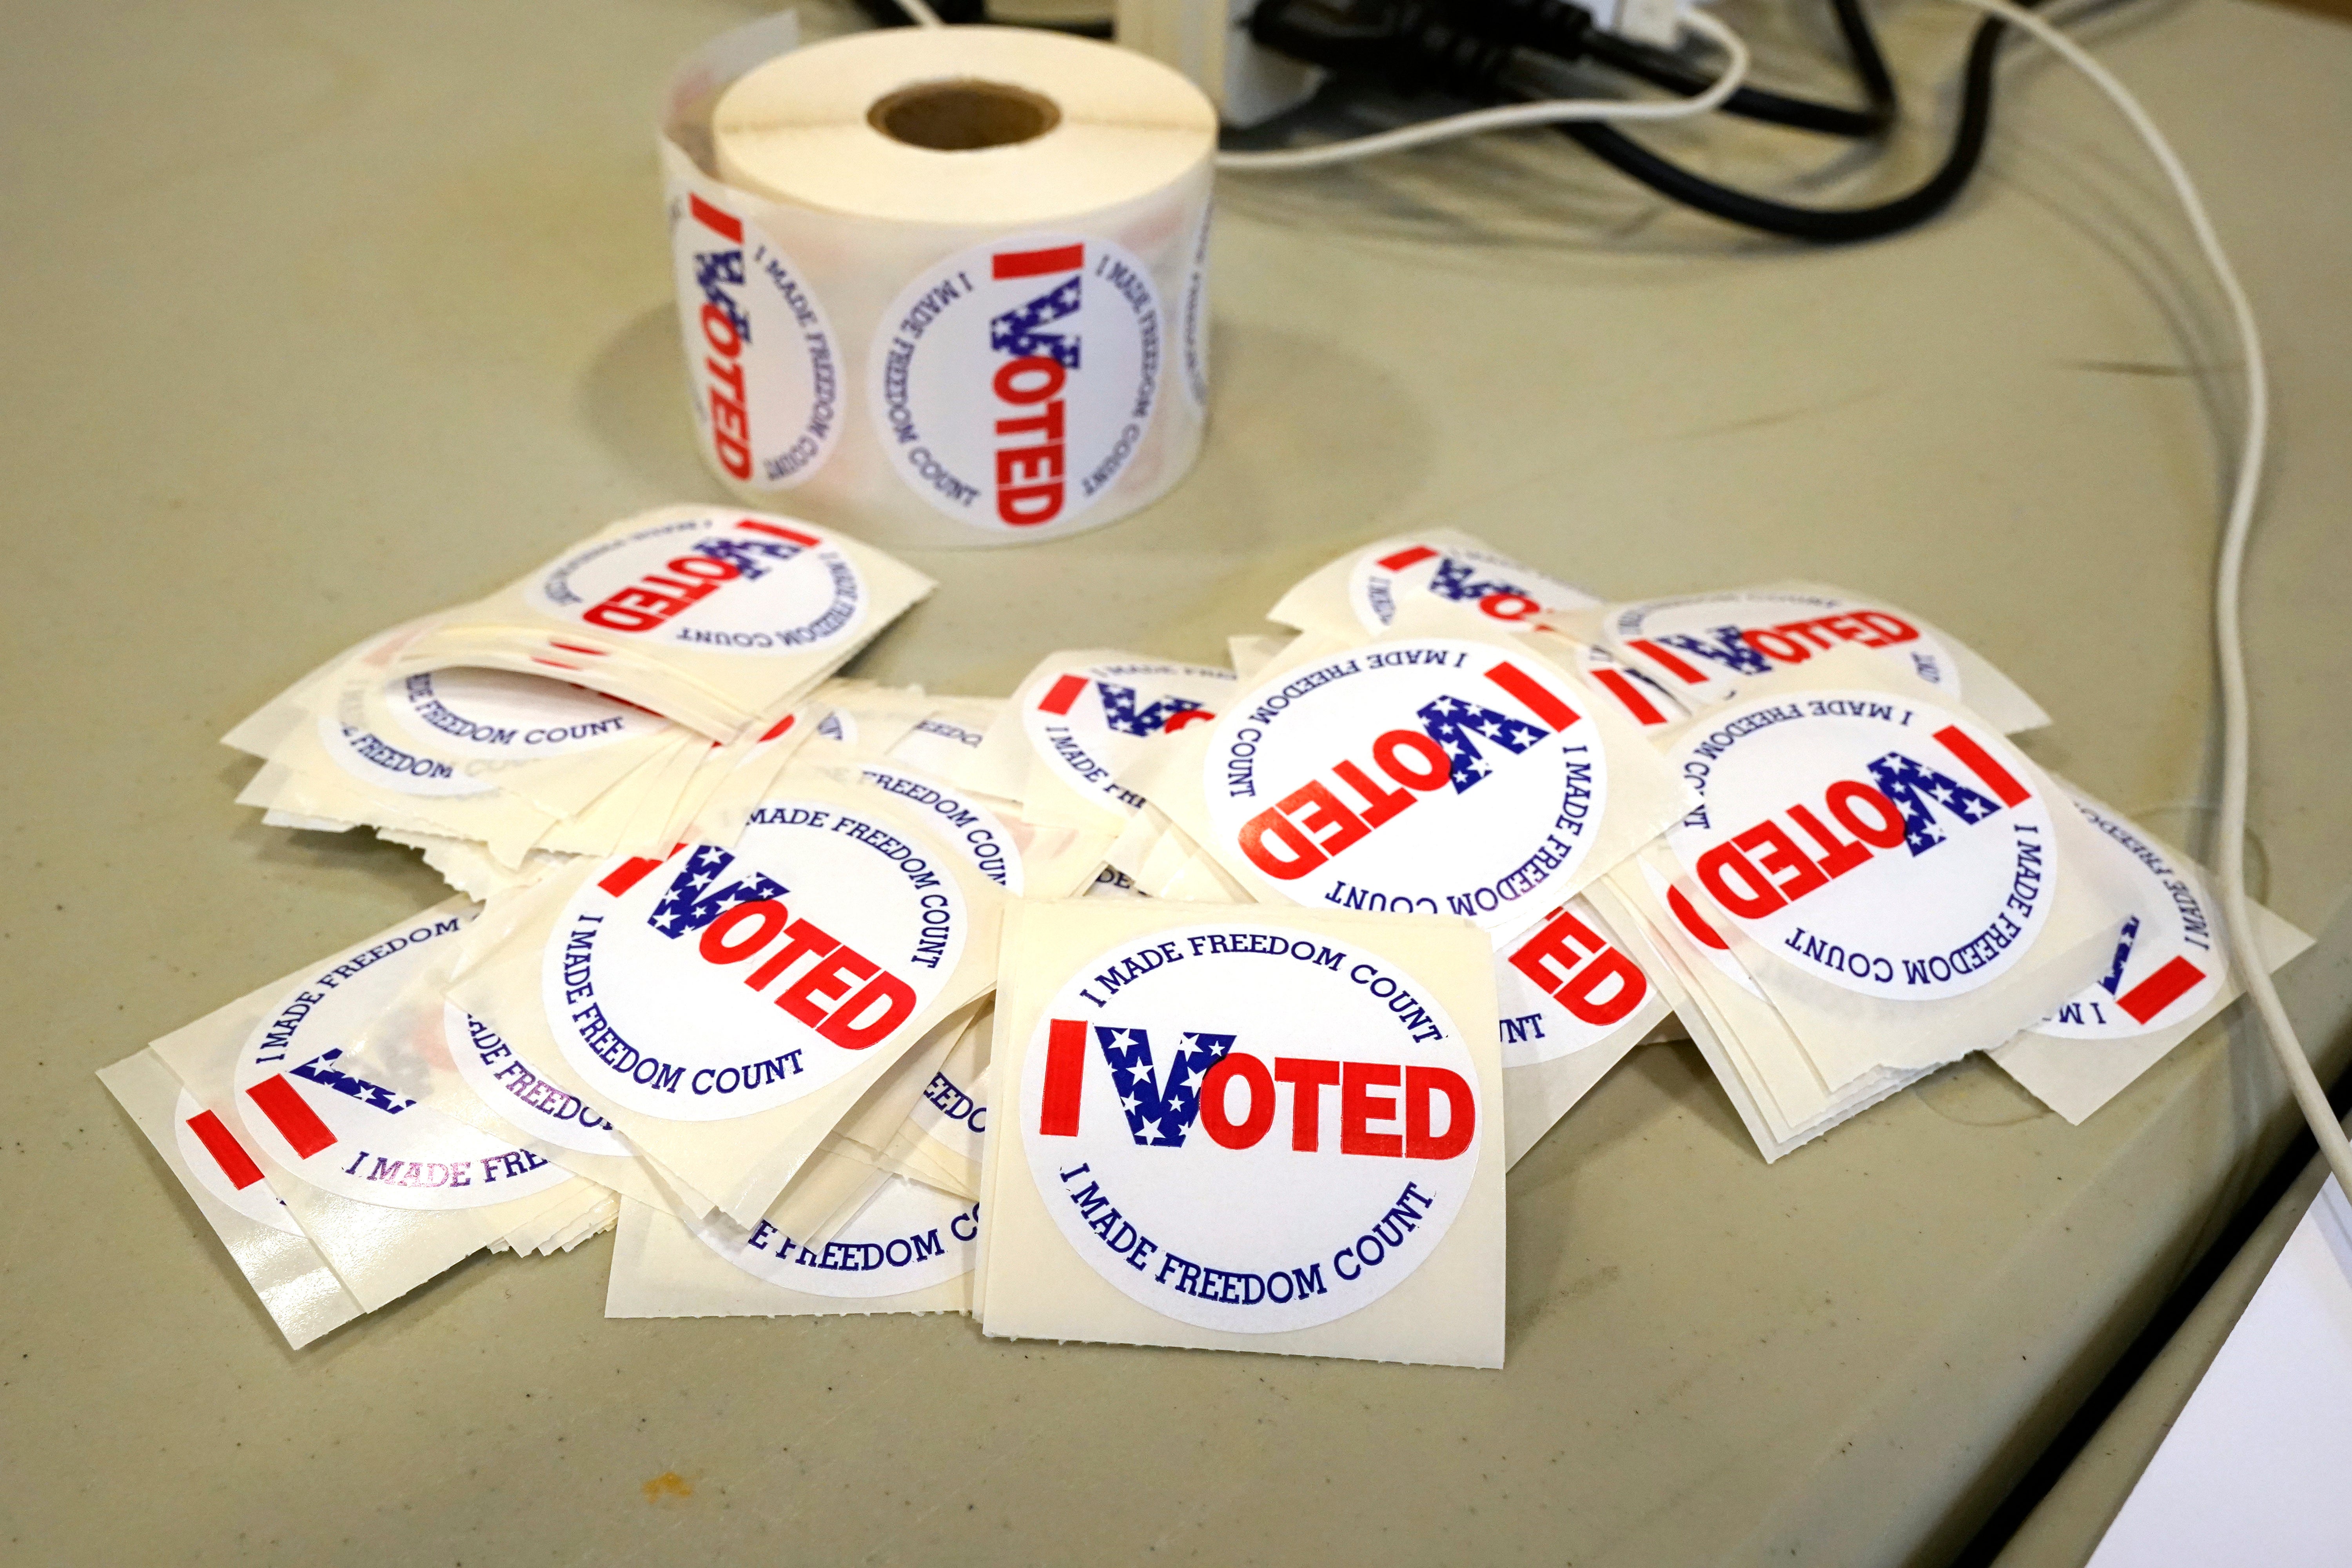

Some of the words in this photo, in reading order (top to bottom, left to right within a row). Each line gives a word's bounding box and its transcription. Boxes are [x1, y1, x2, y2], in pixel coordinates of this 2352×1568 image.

[991, 243, 1085, 281] I
[695, 250, 753, 481] VOTED
[990, 277, 1082, 527] VOTED
[581, 537, 802, 633] VOTED
[1367, 650, 1448, 669] MADE
[1657, 610, 1920, 675] VOTED
[524, 711, 624, 744] COUNT
[1249, 660, 1361, 724] FREEDOM
[1484, 661, 1581, 733] I
[1808, 700, 1893, 721] MADE
[1050, 736, 1109, 782] MADE
[1228, 728, 1262, 797] COUNT
[1693, 704, 1804, 760] FREEDOM
[1932, 724, 2032, 809] I
[1239, 695, 1550, 880] VOTED
[1555, 761, 1592, 835] MADE
[1696, 751, 2002, 920] VOTED
[831, 817, 937, 889] FREEDOM
[911, 894, 951, 969] COUNT
[1446, 835, 1572, 916] FREEDOM
[2006, 840, 2042, 918] MADE
[261, 991, 325, 1047] MADE
[317, 917, 459, 988] FREEDOM
[563, 930, 597, 1005] MADE
[647, 844, 916, 1050] VOTED
[1784, 927, 1894, 983] COUNT
[1902, 915, 2022, 985] FREEDOM
[1081, 989, 1107, 1008] I
[1095, 941, 1183, 995] MADE
[1189, 934, 1347, 971] FREEDOM
[1350, 964, 1443, 1041] COUNT
[572, 1004, 684, 1093] FREEDOM
[691, 1049, 804, 1095] COUNT
[1039, 1018, 1088, 1137] I
[1094, 1026, 1475, 1161] VOTED
[345, 1151, 369, 1175] I
[366, 1157, 471, 1187] MADE
[1061, 1163, 1090, 1183] I
[1072, 1180, 1157, 1271] MADE
[1334, 1181, 1433, 1280] COUNT
[1155, 1252, 1327, 1305] FREEDOM
